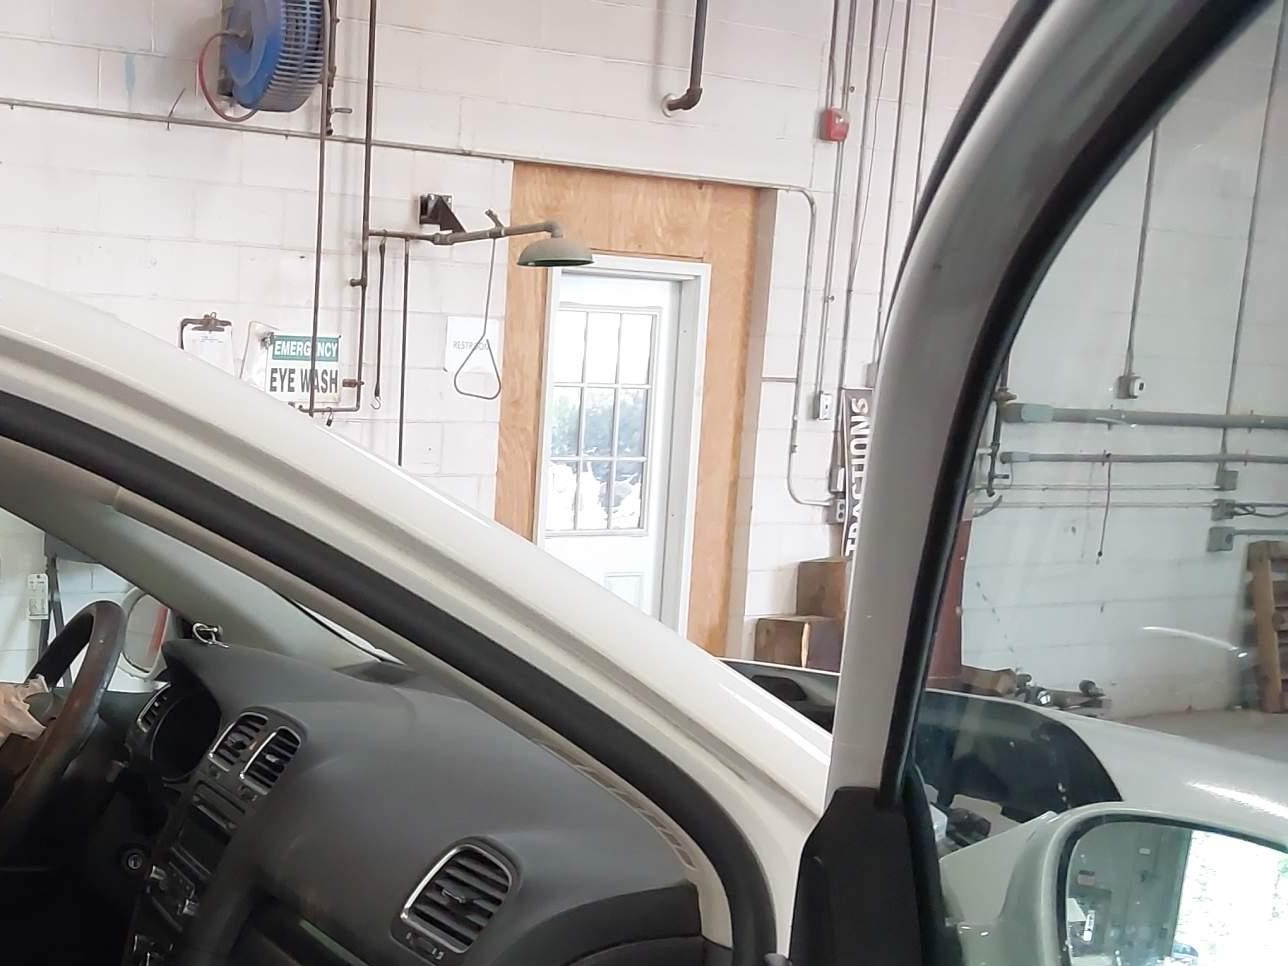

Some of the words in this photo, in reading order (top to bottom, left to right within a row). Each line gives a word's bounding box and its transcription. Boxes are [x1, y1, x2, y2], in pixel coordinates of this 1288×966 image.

[274, 340, 338, 357] EMERGNCY
[269, 367, 296, 393] EYE
[300, 368, 338, 394] WASH
